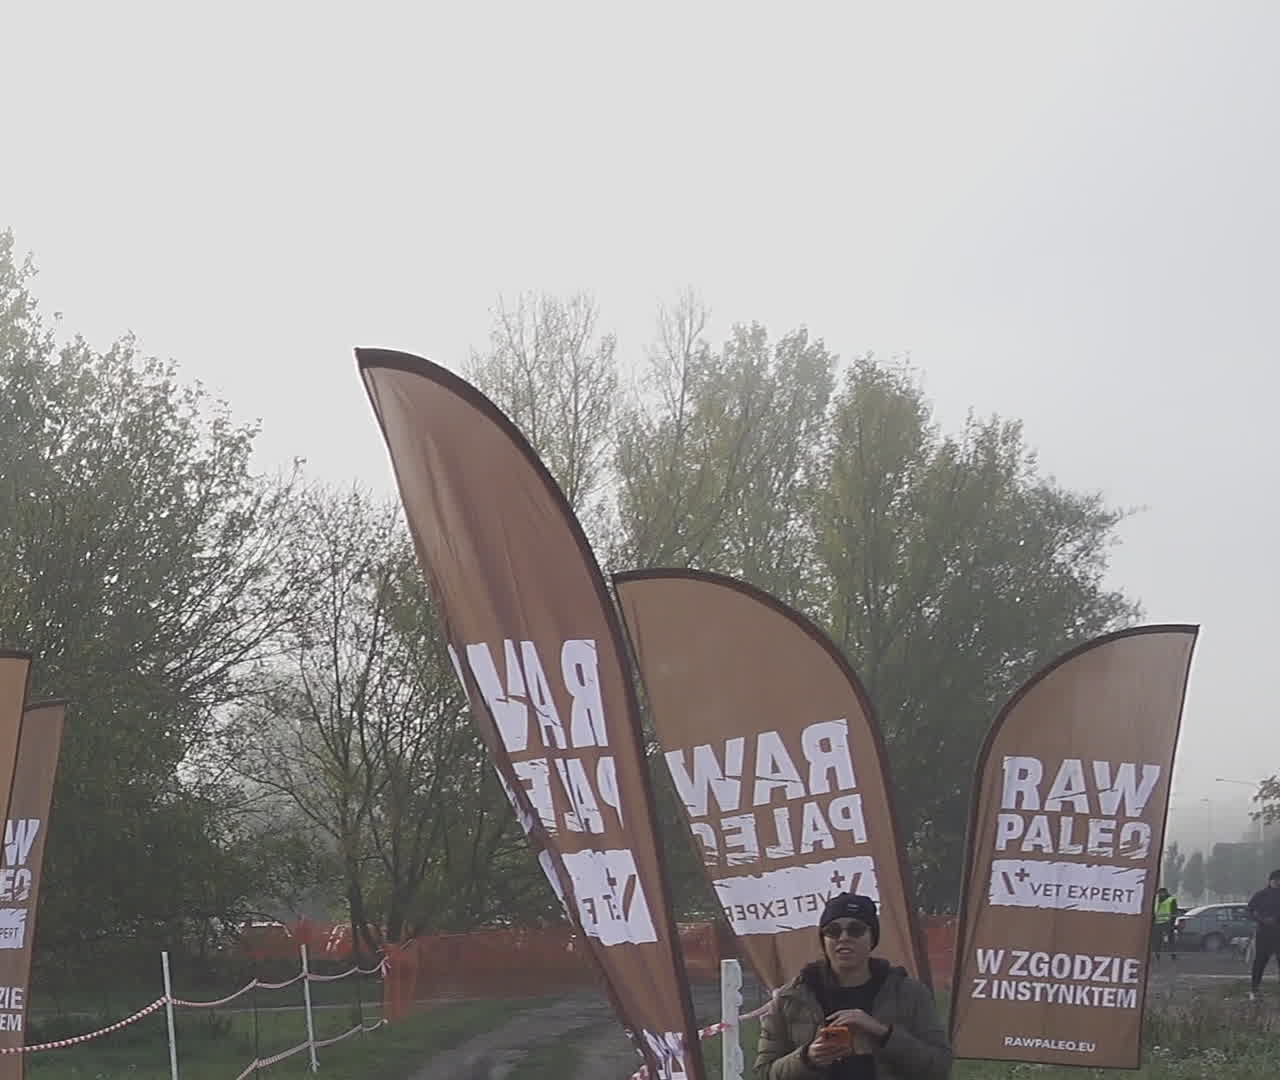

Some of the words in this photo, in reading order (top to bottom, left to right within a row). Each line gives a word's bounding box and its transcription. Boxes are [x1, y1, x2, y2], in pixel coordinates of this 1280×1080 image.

[1001, 755, 1161, 818] RAW
[995, 812, 1153, 860] PALEO
[1030, 883, 1062, 897] VET
[1067, 884, 1136, 904] EXPERT
[975, 948, 1004, 975] W
[1009, 949, 1140, 984] ZGODZIE
[971, 978, 989, 999] Z
[991, 979, 1137, 1009] INSTYNKTEM
[1004, 1036, 1096, 1053] RAWPALEO.EU
